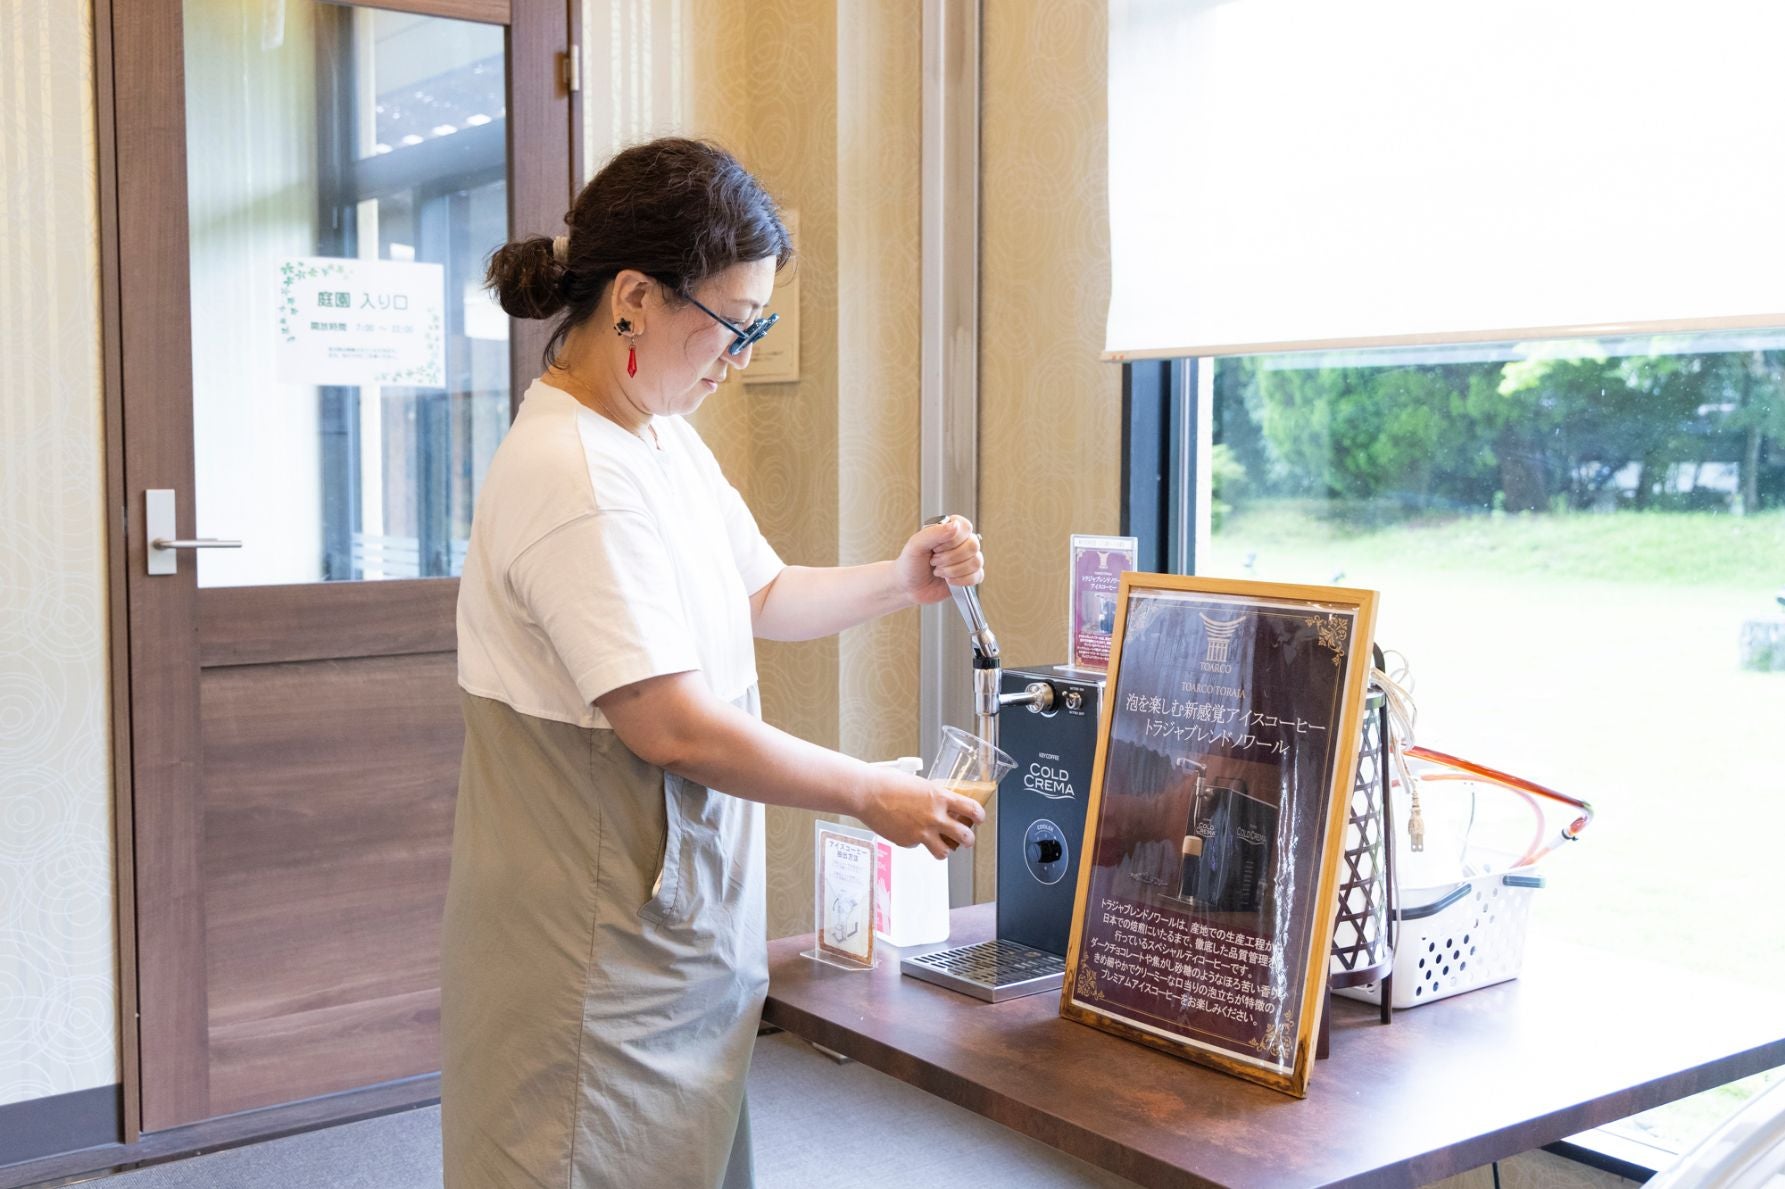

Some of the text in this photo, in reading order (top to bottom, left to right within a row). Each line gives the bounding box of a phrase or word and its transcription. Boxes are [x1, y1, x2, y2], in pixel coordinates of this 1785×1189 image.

[318, 291, 408, 310] 庭園 入り口
[1200, 661, 1232, 674] TOARCO
[1182, 682, 1246, 699] TOARCO TORAJA
[1126, 693, 1326, 734] 泡を楽しむ新感覚アイスコーヒー
[1145, 718, 1290, 754] トラジャブレンドノワール
[1029, 763, 1069, 782] COLD
[1023, 775, 1075, 796] CREMA
